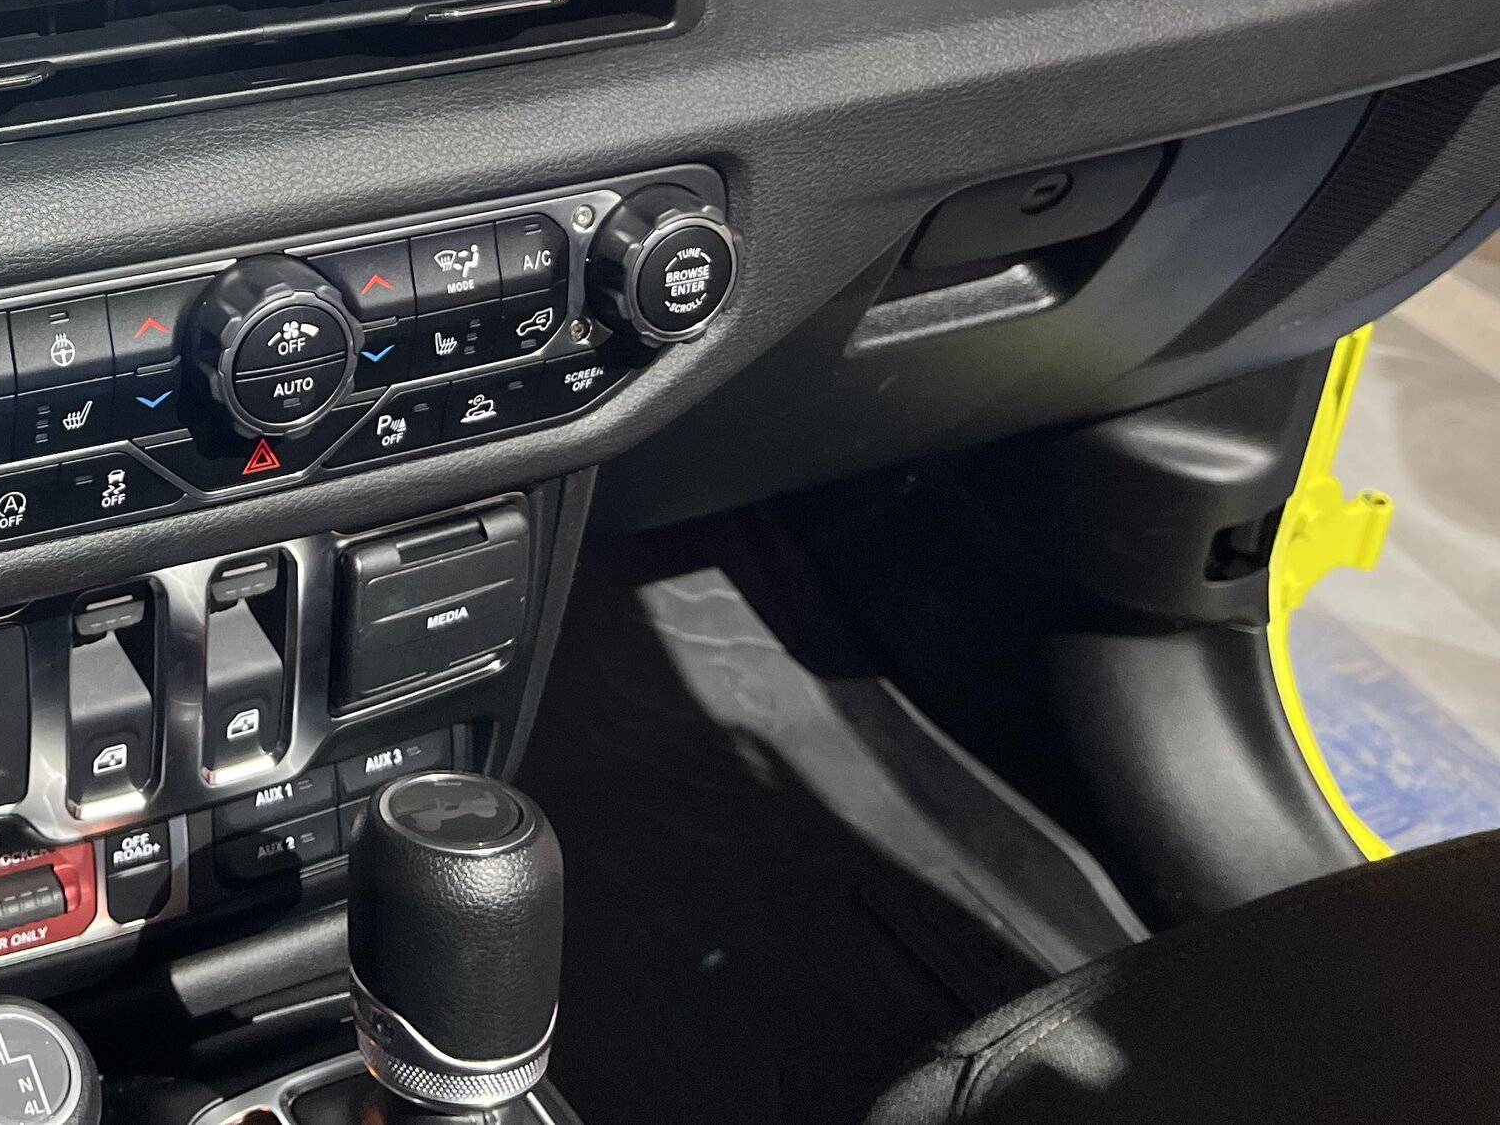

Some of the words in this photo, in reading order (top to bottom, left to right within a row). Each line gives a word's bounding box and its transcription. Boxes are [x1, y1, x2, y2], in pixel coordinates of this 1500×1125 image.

[523, 249, 552, 271] A/C
[677, 247, 701, 260] TUNE
[665, 264, 710, 283] BROWSE
[447, 279, 476, 294] MODE
[671, 281, 705, 297] ENTER
[669, 298, 702, 313] SCROLL
[277, 336, 307, 356] OFF
[273, 376, 314, 398] AUTO
[572, 378, 593, 392] OFF
[381, 431, 404, 447] OFF
[101, 492, 126, 509] OFF
[426, 606, 469, 629] MEDIA
[365, 749, 393, 773] AUX
[394, 748, 403, 764] 3
[255, 787, 283, 807] AUX
[287, 784, 293, 799] 1
[121, 833, 149, 851] OFF
[10, 926, 48, 946] ONLY
[18, 1077, 33, 1093] N
[24, 1100, 44, 1116] 4L
